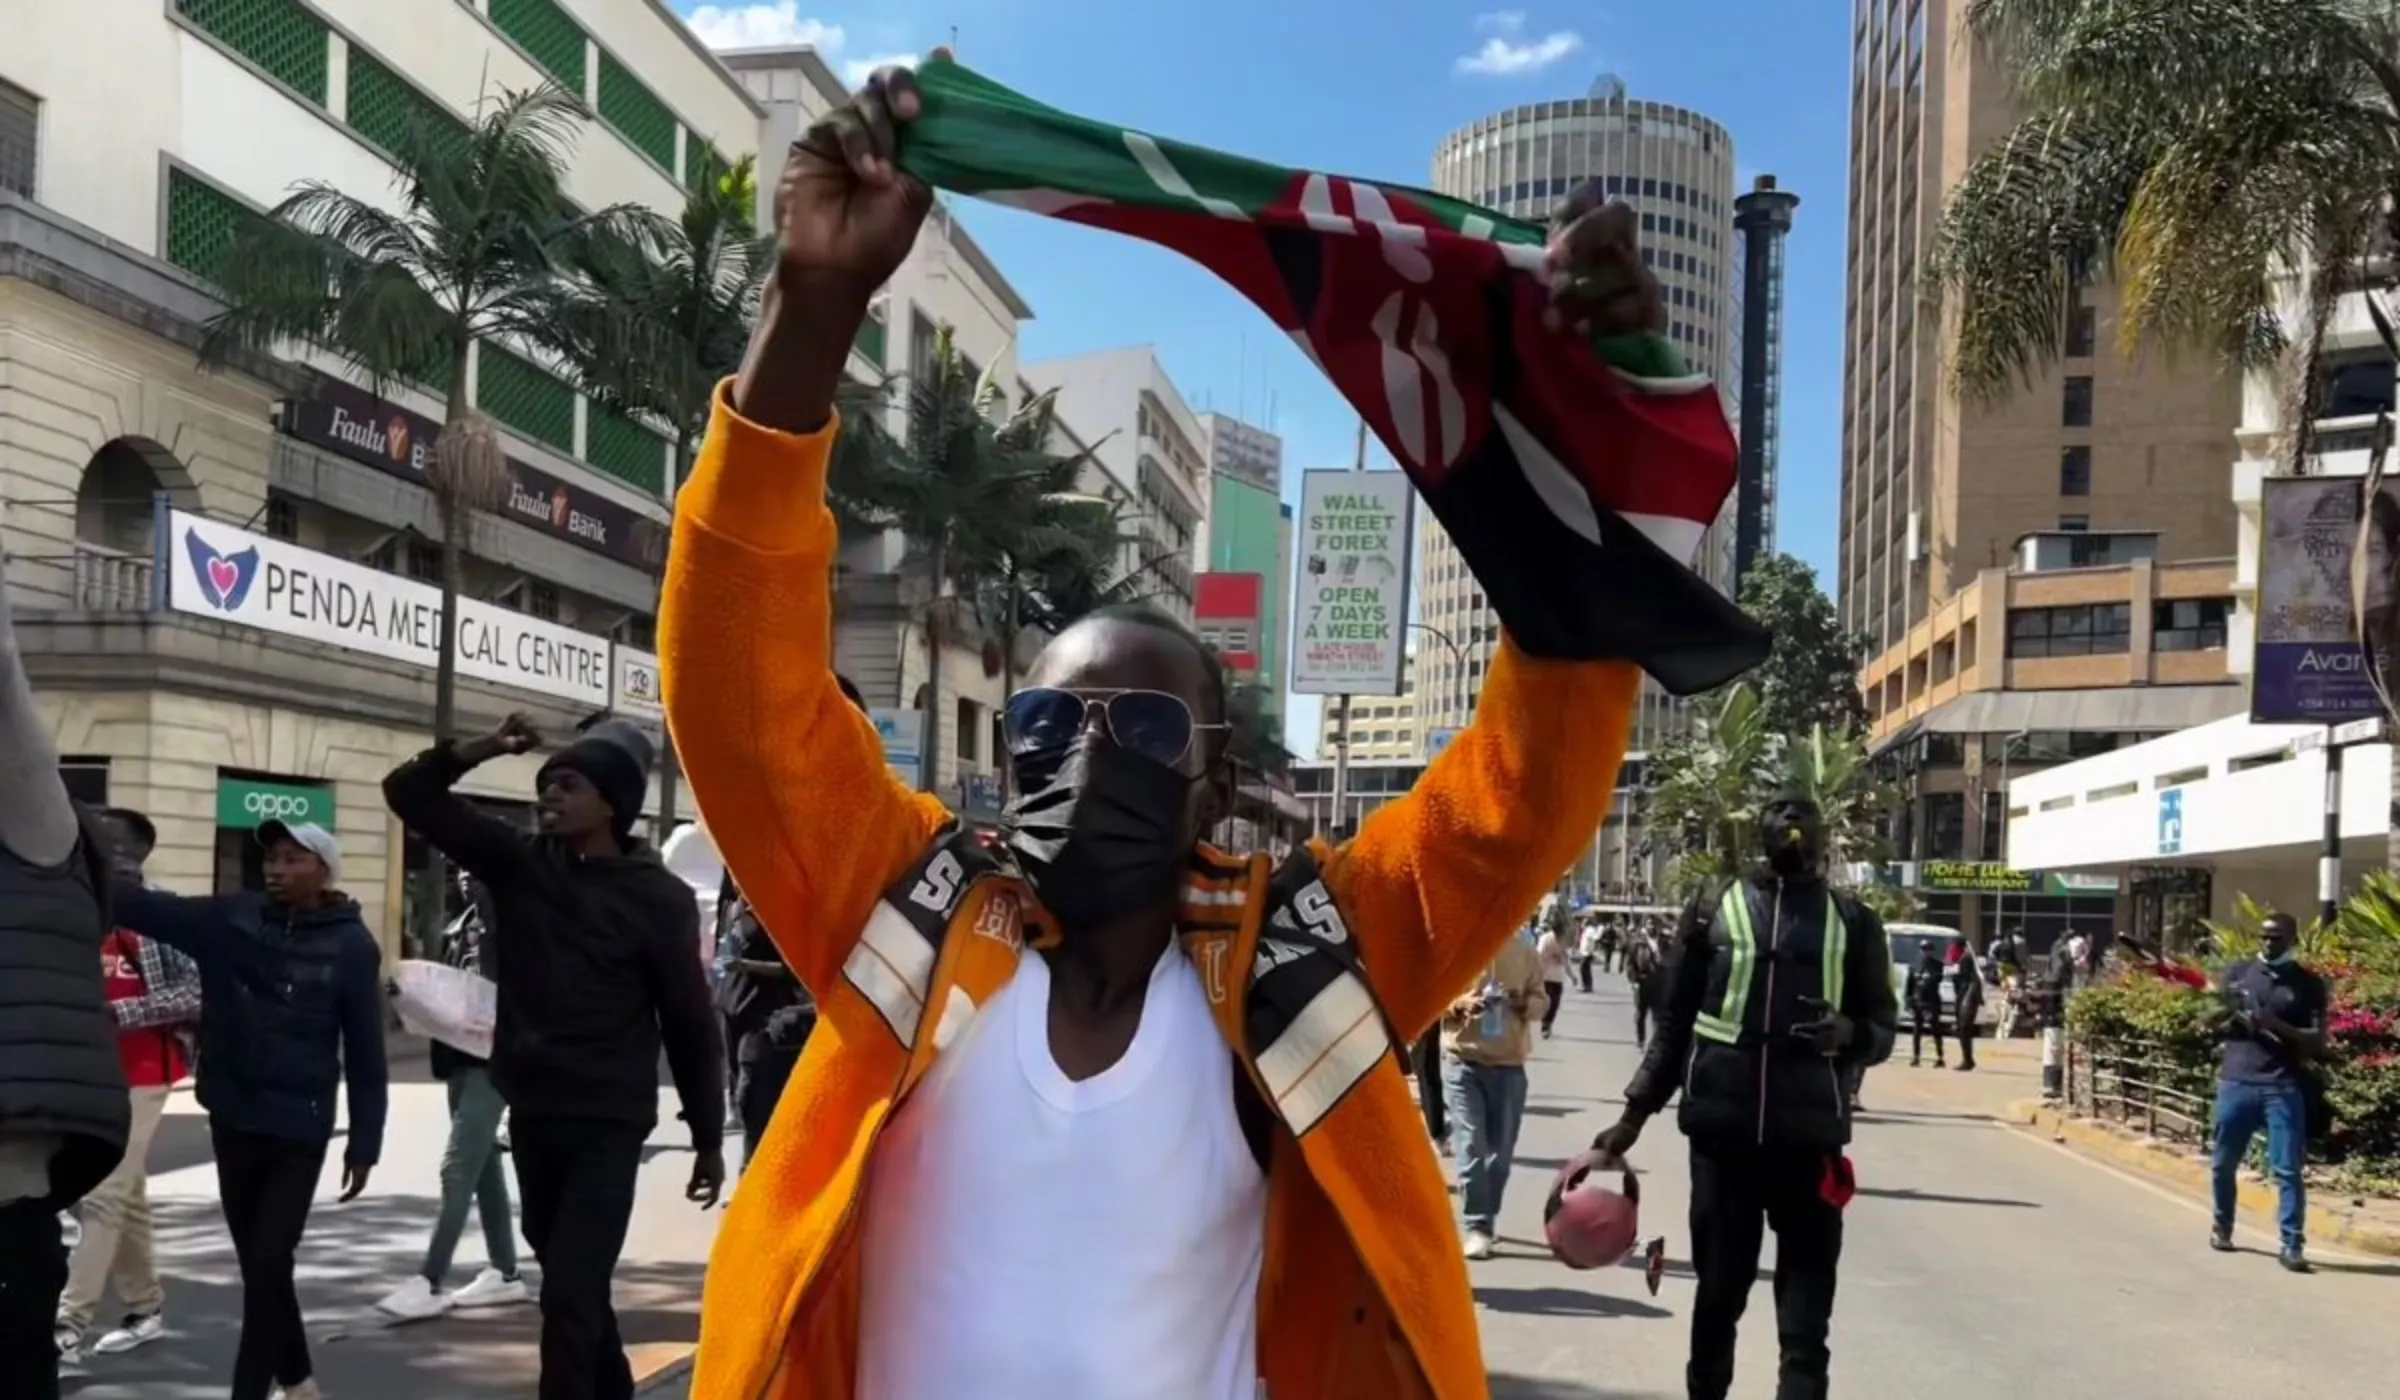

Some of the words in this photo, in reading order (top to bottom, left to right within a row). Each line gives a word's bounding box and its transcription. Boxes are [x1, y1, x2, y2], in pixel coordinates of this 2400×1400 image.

[329, 406, 385, 454] Faulu
[1323, 495, 1385, 510] WALL
[508, 483, 550, 520] Faulu
[568, 510, 606, 544] Bank
[1310, 514, 1396, 531] STREET
[1315, 535, 1388, 551] FOREX
[1318, 587, 1379, 602] OPEN
[1310, 605, 1323, 620] 7
[1330, 605, 1387, 621] DAYS
[267, 562, 378, 637] PENDA
[388, 597, 508, 666] MEDCAL
[516, 632, 603, 689] CENTRE
[1304, 623, 1318, 639] A
[1327, 623, 1390, 639] WEEK
[244, 791, 309, 819] oppo
